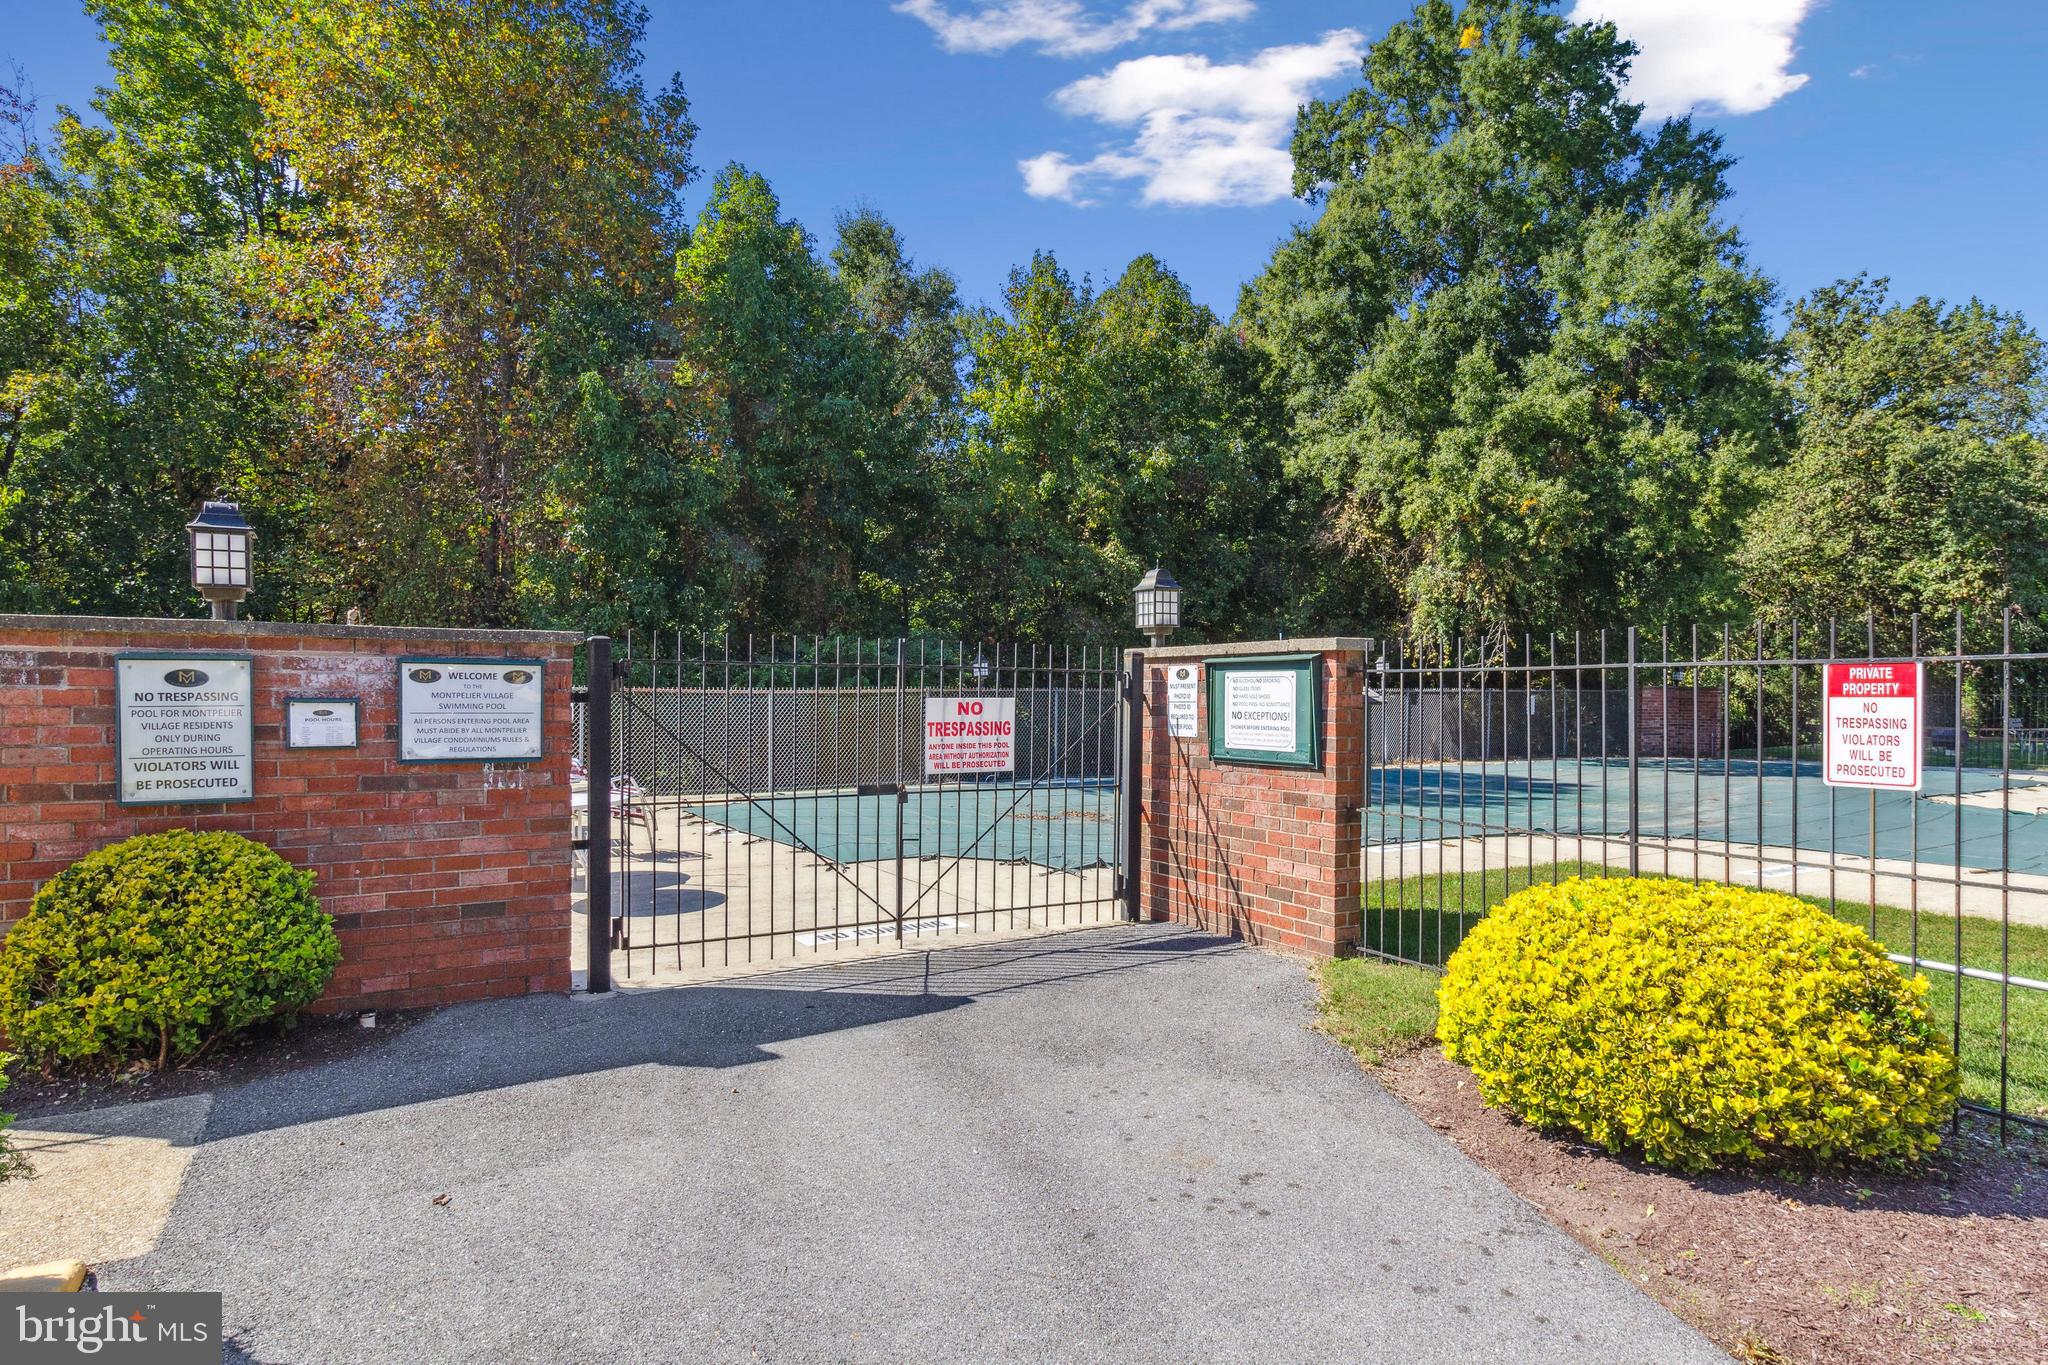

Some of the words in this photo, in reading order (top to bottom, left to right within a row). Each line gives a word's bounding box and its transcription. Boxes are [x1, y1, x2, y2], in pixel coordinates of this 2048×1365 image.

[1850, 667, 1892, 679] PRIVATE
[1843, 683, 1899, 694] PROPERTY
[135, 692, 154, 702] NO
[158, 692, 239, 701] TRESPASSING
[183, 709, 242, 717] MONTPELIER
[958, 702, 983, 715] NO
[1863, 702, 1878, 713] NO
[1232, 711, 1242, 720] NO
[1244, 712, 1290, 721] EXCEPTIONS!
[184, 721, 233, 729] RESIDENTS
[928, 721, 1011, 736] TRESPASSING
[1836, 718, 1907, 729] TRESPASSING
[155, 734, 180, 742] ONLY
[1842, 734, 1900, 746] VIOLATORS
[142, 747, 197, 756] OPERATING
[200, 746, 233, 754] HOURS
[1850, 750, 1873, 761] WILL
[1879, 751, 1892, 762] BE
[134, 761, 206, 772] VIOLATORS
[211, 760, 239, 770] WILL
[1837, 764, 1905, 778] PROSECUTED
[136, 780, 152, 790] BE
[157, 778, 238, 789] PROSECUTED
